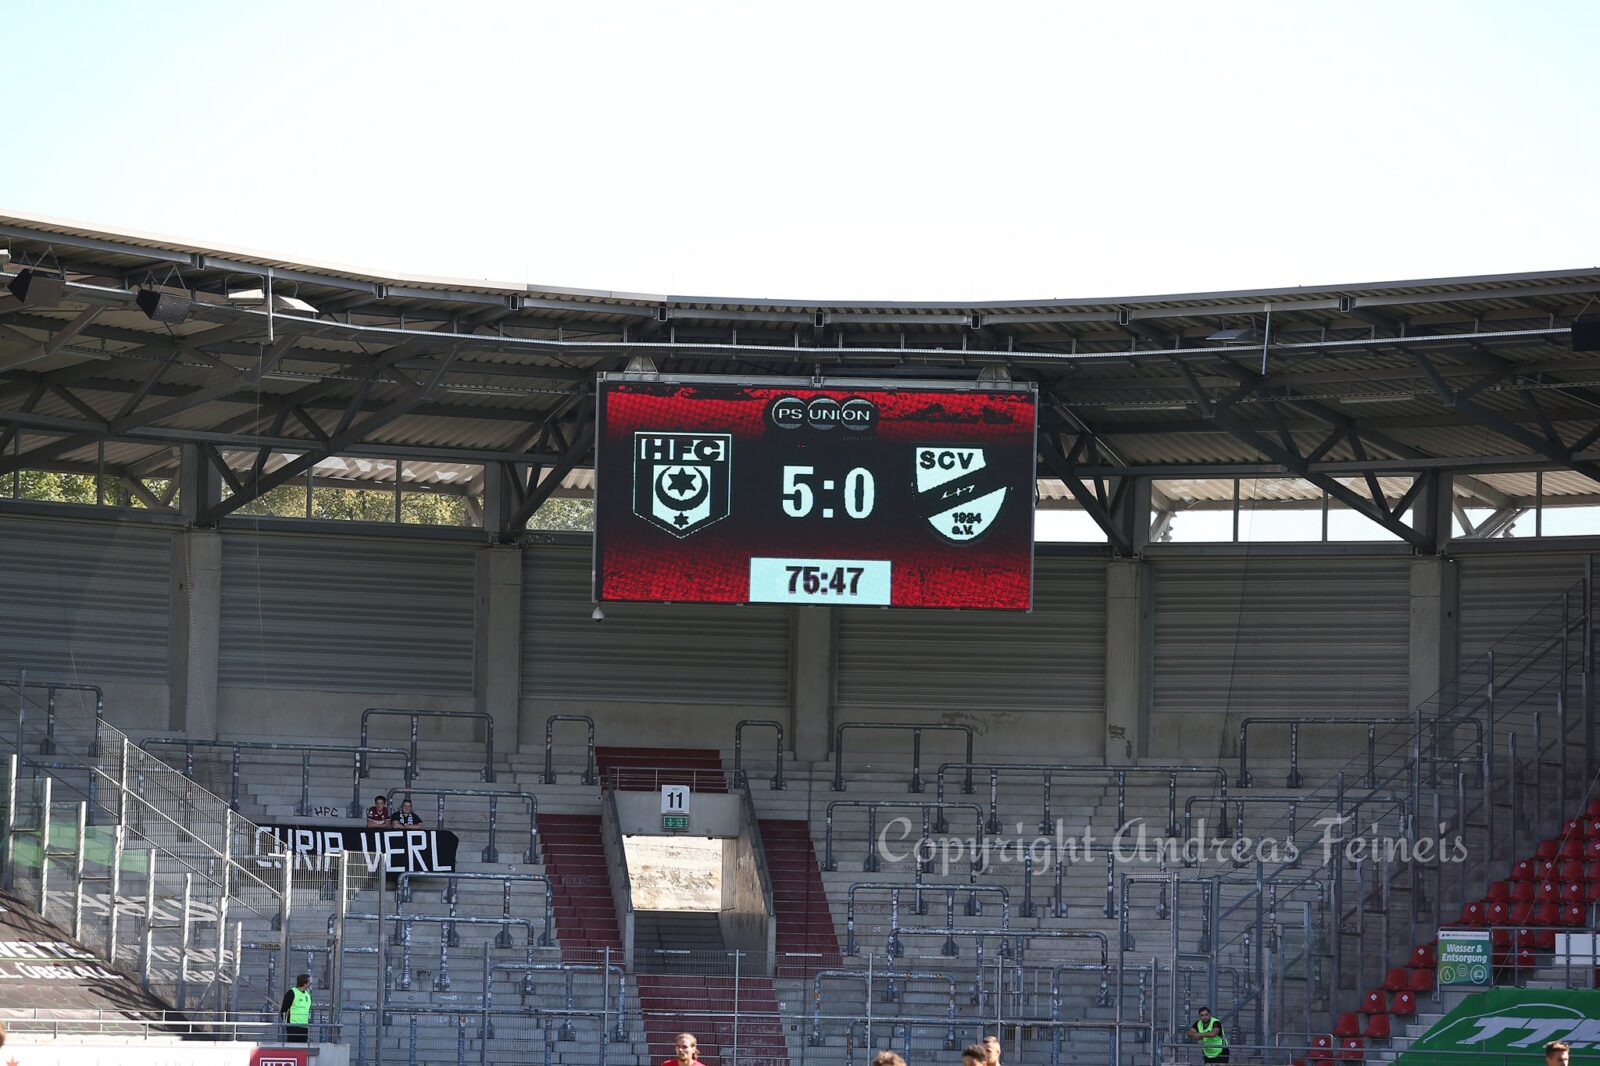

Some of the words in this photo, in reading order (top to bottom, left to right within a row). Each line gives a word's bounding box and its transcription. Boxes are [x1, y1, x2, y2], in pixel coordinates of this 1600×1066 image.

[778, 408, 802, 419] PS
[809, 409, 870, 421] UNION
[645, 438, 721, 461] HFC
[919, 449, 974, 470] SCV
[782, 465, 875, 519] 5:0
[785, 565, 865, 594] 75:47
[667, 792, 683, 809] 11
[315, 806, 338, 817] HFC
[360, 831, 452, 873] VERL
[1446, 944, 1475, 953] Wasser
[1476, 944, 1483, 953] &
[1442, 954, 1487, 964] Entsorgung
